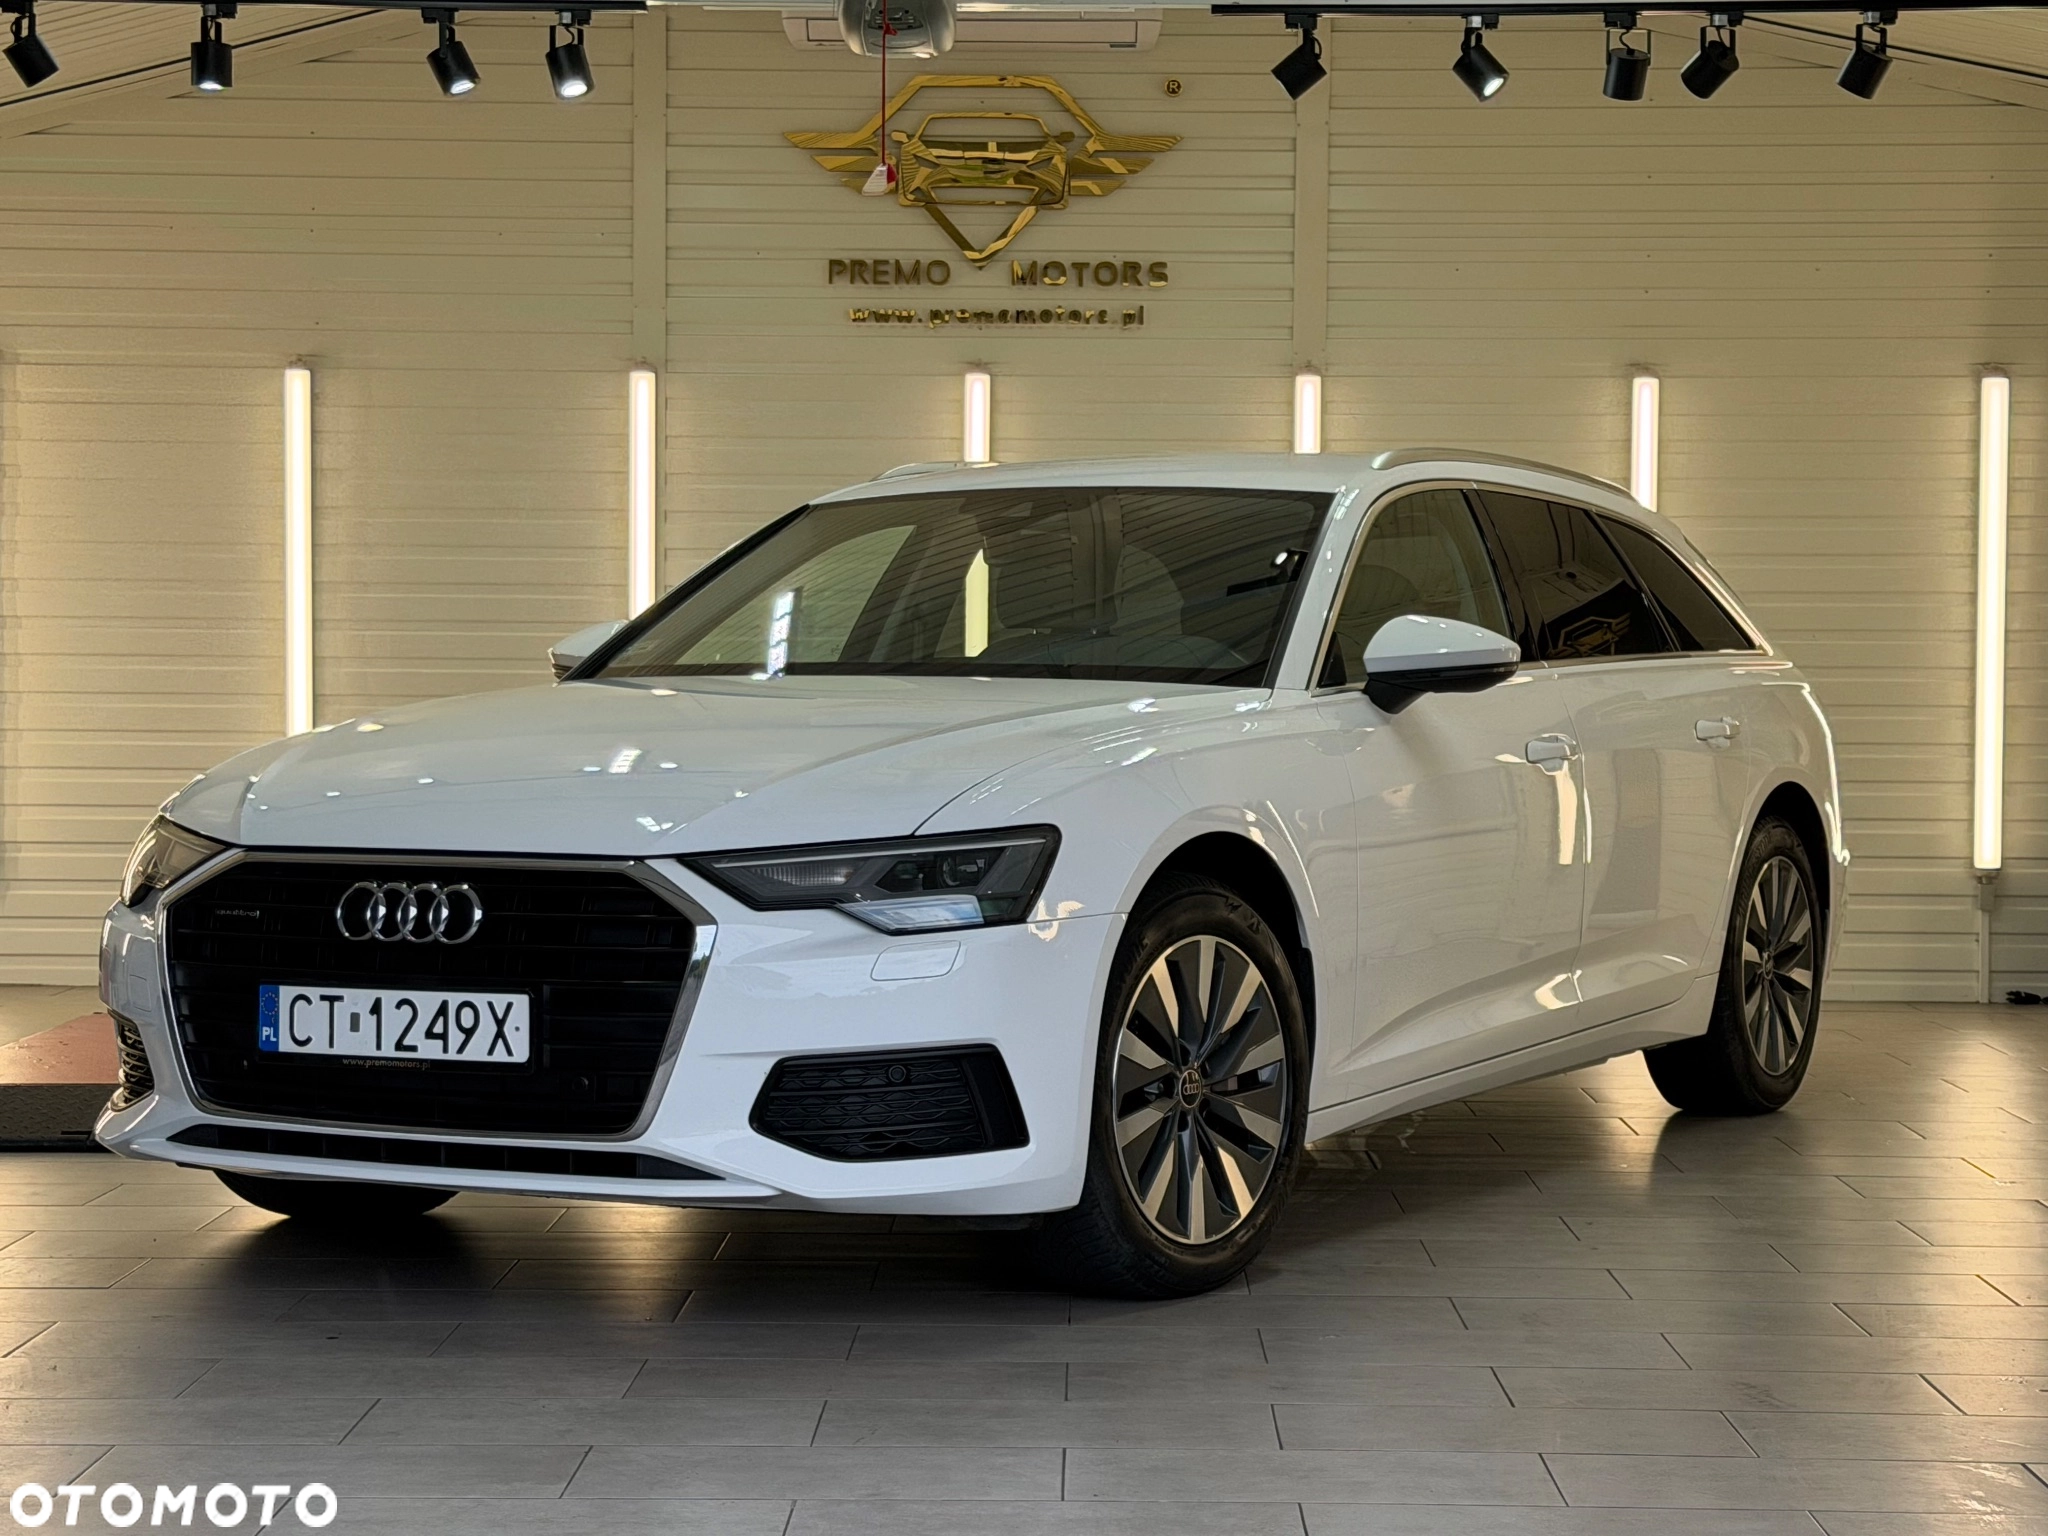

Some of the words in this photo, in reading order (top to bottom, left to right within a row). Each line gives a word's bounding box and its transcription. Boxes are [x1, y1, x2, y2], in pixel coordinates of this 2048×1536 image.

[828, 259, 951, 286] PREMO
[1011, 260, 1169, 287] MOTORS
[262, 1026, 277, 1042] PL
[288, 993, 345, 1050] CT
[368, 996, 515, 1058] 1249X
[342, 1058, 431, 1071] www.premomotors.pl
